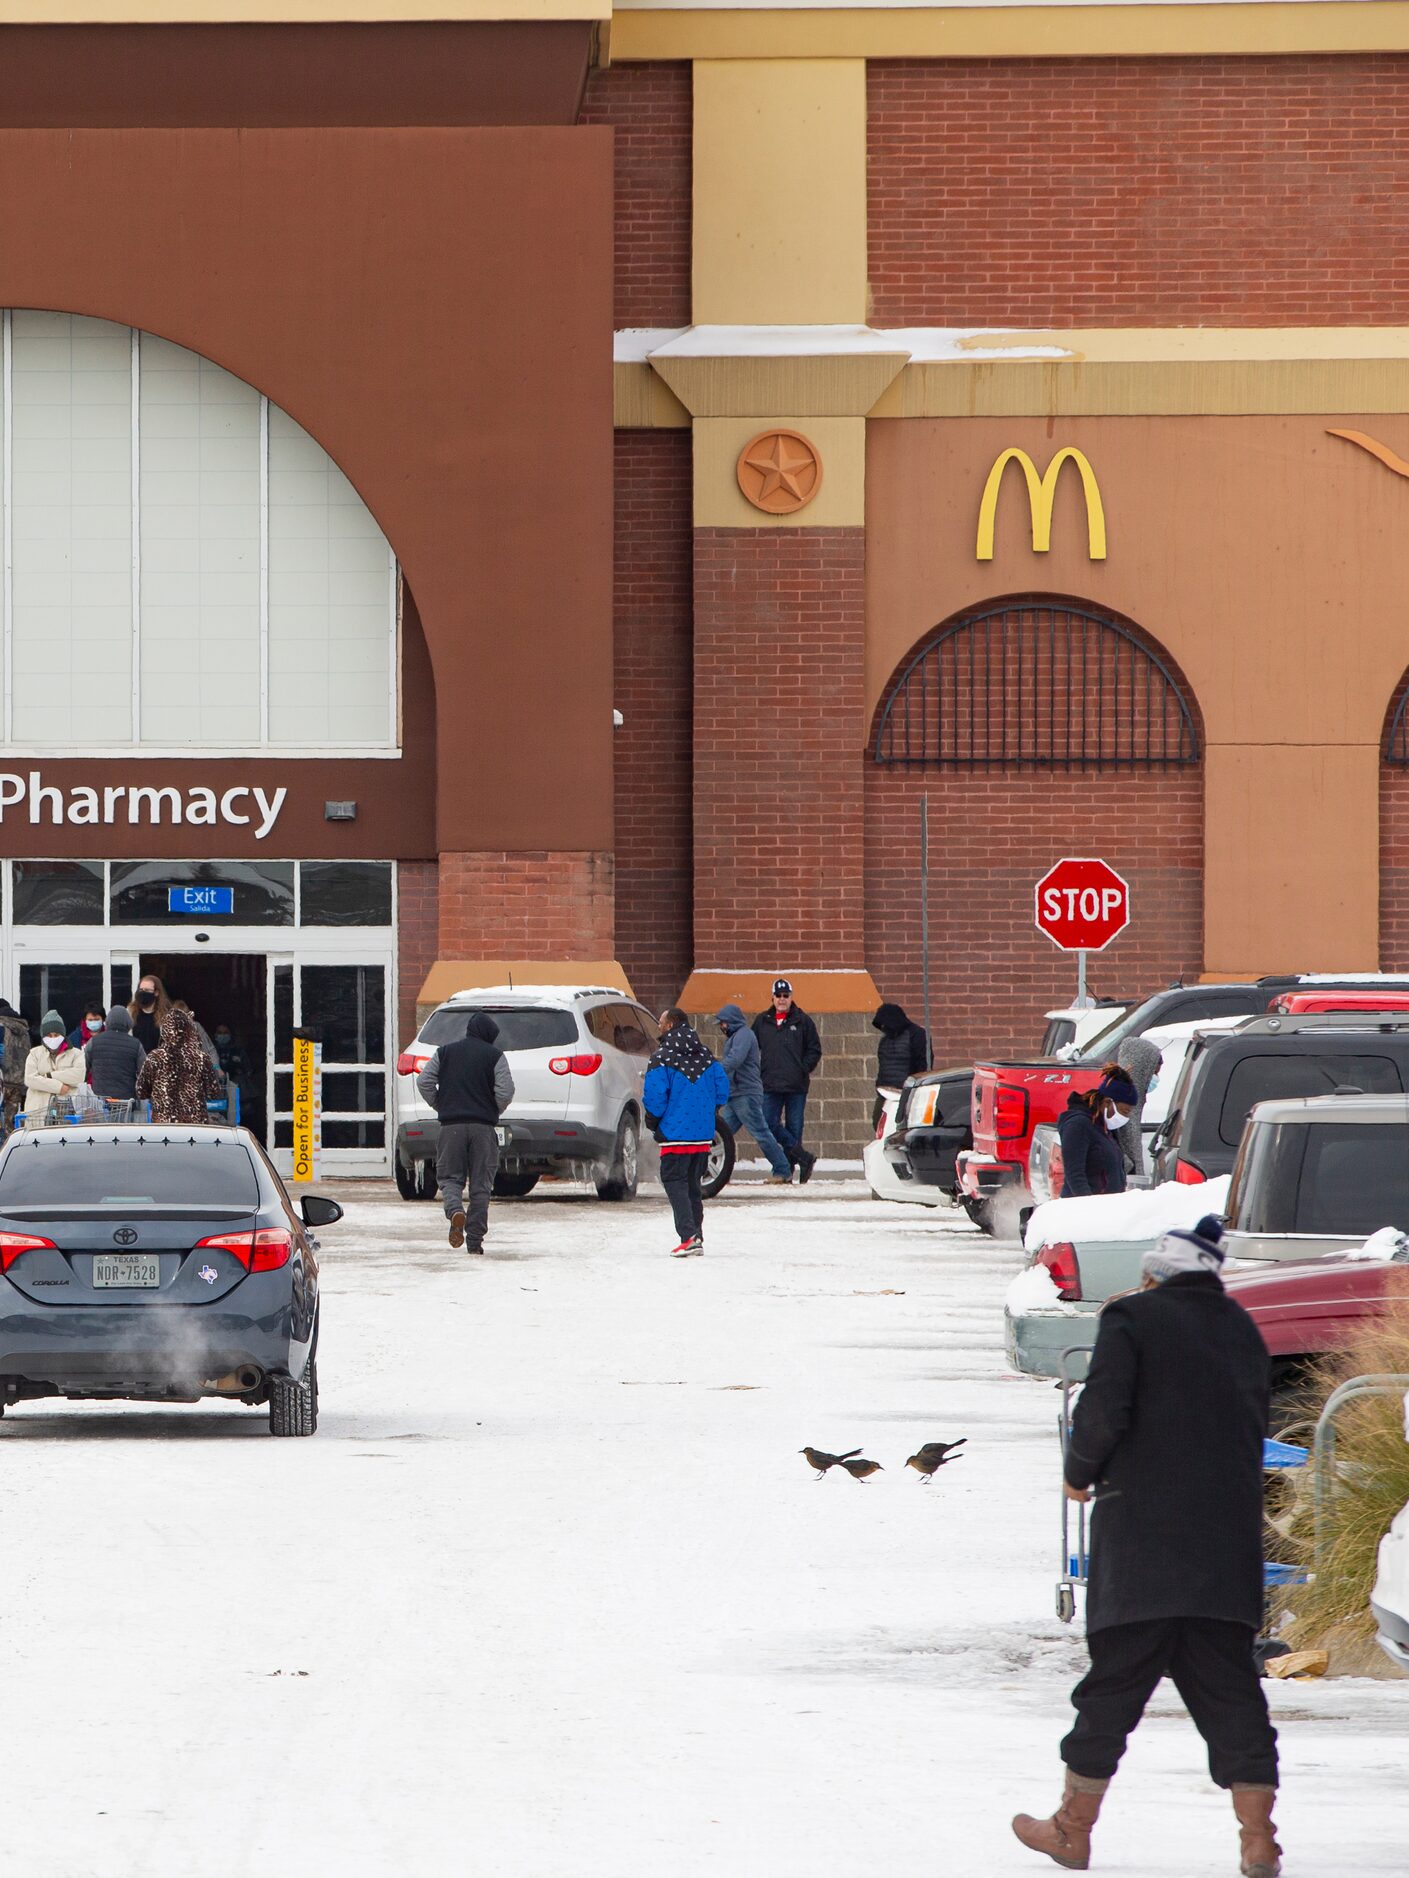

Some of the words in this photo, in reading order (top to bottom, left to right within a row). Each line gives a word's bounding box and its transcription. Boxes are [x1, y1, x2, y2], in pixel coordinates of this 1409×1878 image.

[184, 887, 217, 905] Exit
[1043, 887, 1122, 922] STOP
[296, 1039, 309, 1103] Business
[296, 1107, 309, 1130] for
[296, 1134, 312, 1176] Open
